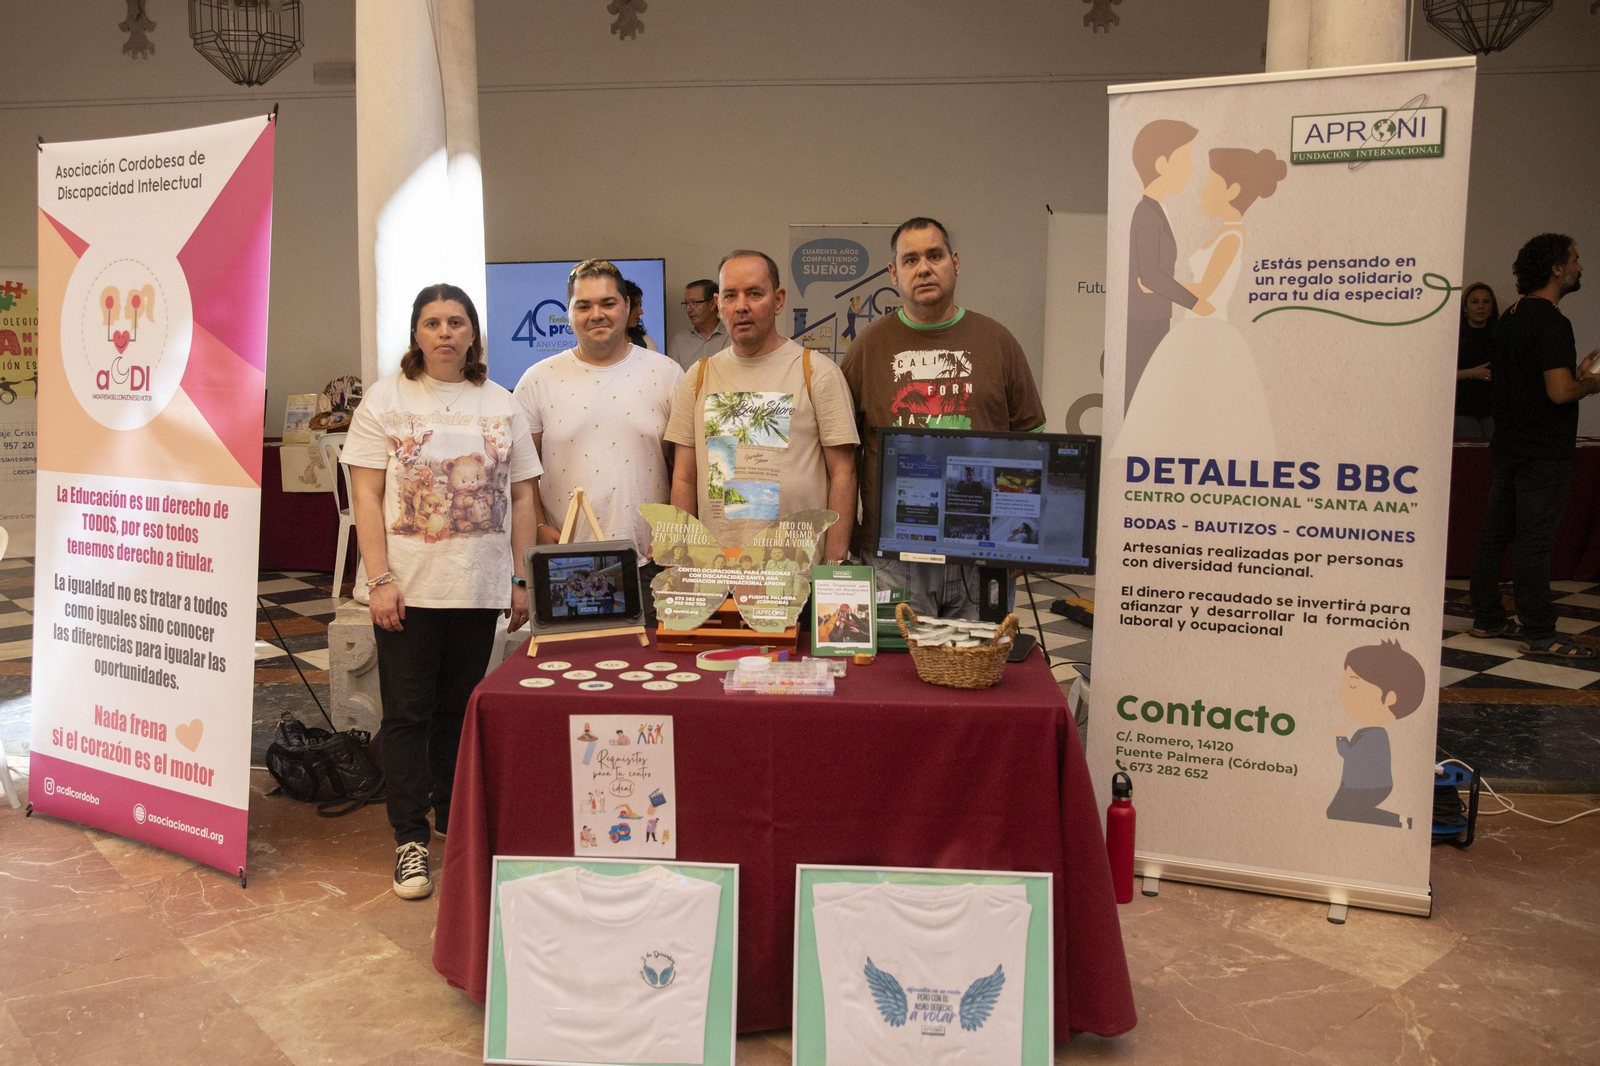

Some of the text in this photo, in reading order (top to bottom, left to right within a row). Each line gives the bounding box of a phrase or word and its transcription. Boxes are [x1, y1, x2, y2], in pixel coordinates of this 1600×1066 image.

[55, 150, 206, 179] Asociación Cordobesa de
[1293, 146, 1440, 161] FUNDACIÓN INTERNACIONAL
[58, 174, 202, 201] Discapacidad Intelectual
[803, 262, 857, 275] SUEÑOS
[1252, 256, 1416, 272] ¿Estás pensando en
[1255, 271, 1413, 288] un regalo solidario
[1248, 288, 1423, 304] para tu día especial?
[898, 357, 936, 368] CALI
[928, 384, 972, 396] FORN
[733, 399, 797, 420] Bay Shore
[3, 442, 18, 450] 957
[1126, 456, 1420, 494] DETALLES BBC
[56, 485, 229, 520] La Educación es un derecho de
[1124, 490, 1185, 503] CENTRO
[1190, 492, 1302, 508] OCUPACIONAL
[82, 512, 199, 544] TODOS, por eso todos
[778, 521, 812, 530] PERO CON
[784, 530, 812, 539] MISMO
[1124, 517, 1416, 544] BODAS BAUTIZOS COMUNIONES
[753, 538, 782, 547] DERECHO
[67, 538, 214, 573] tenemos derecho a titular.
[1122, 541, 1404, 568] Artesanías realizadas por personas
[1122, 557, 1314, 578] con diversidad funcional.
[54, 573, 228, 618] La igualdad no es tratar a todos
[1121, 586, 1411, 616] El dinero recaudado se invertirá para
[64, 602, 214, 643] como iguales sino conocer
[1120, 600, 1410, 631] afianzar y desarrollar la formación
[1120, 614, 1283, 637] laboral y ocupacional
[53, 623, 226, 673] las diferencias para igualar las
[94, 658, 179, 690] oportunidades.
[94, 704, 167, 742] Nada frena
[1116, 695, 1296, 736] Contacto
[1116, 731, 1234, 752] C/. Romero, 14120
[52, 727, 215, 787] si el corazón es el motor
[1116, 746, 1298, 777] Fuente Palmera (Córdoba)
[628, 767, 651, 779] centro
[1129, 762, 1209, 780] 673 282 652
[56, 784, 100, 805] acdicordoba
[612, 783, 633, 794] ideal
[148, 814, 224, 845] asociacionacdi.org
